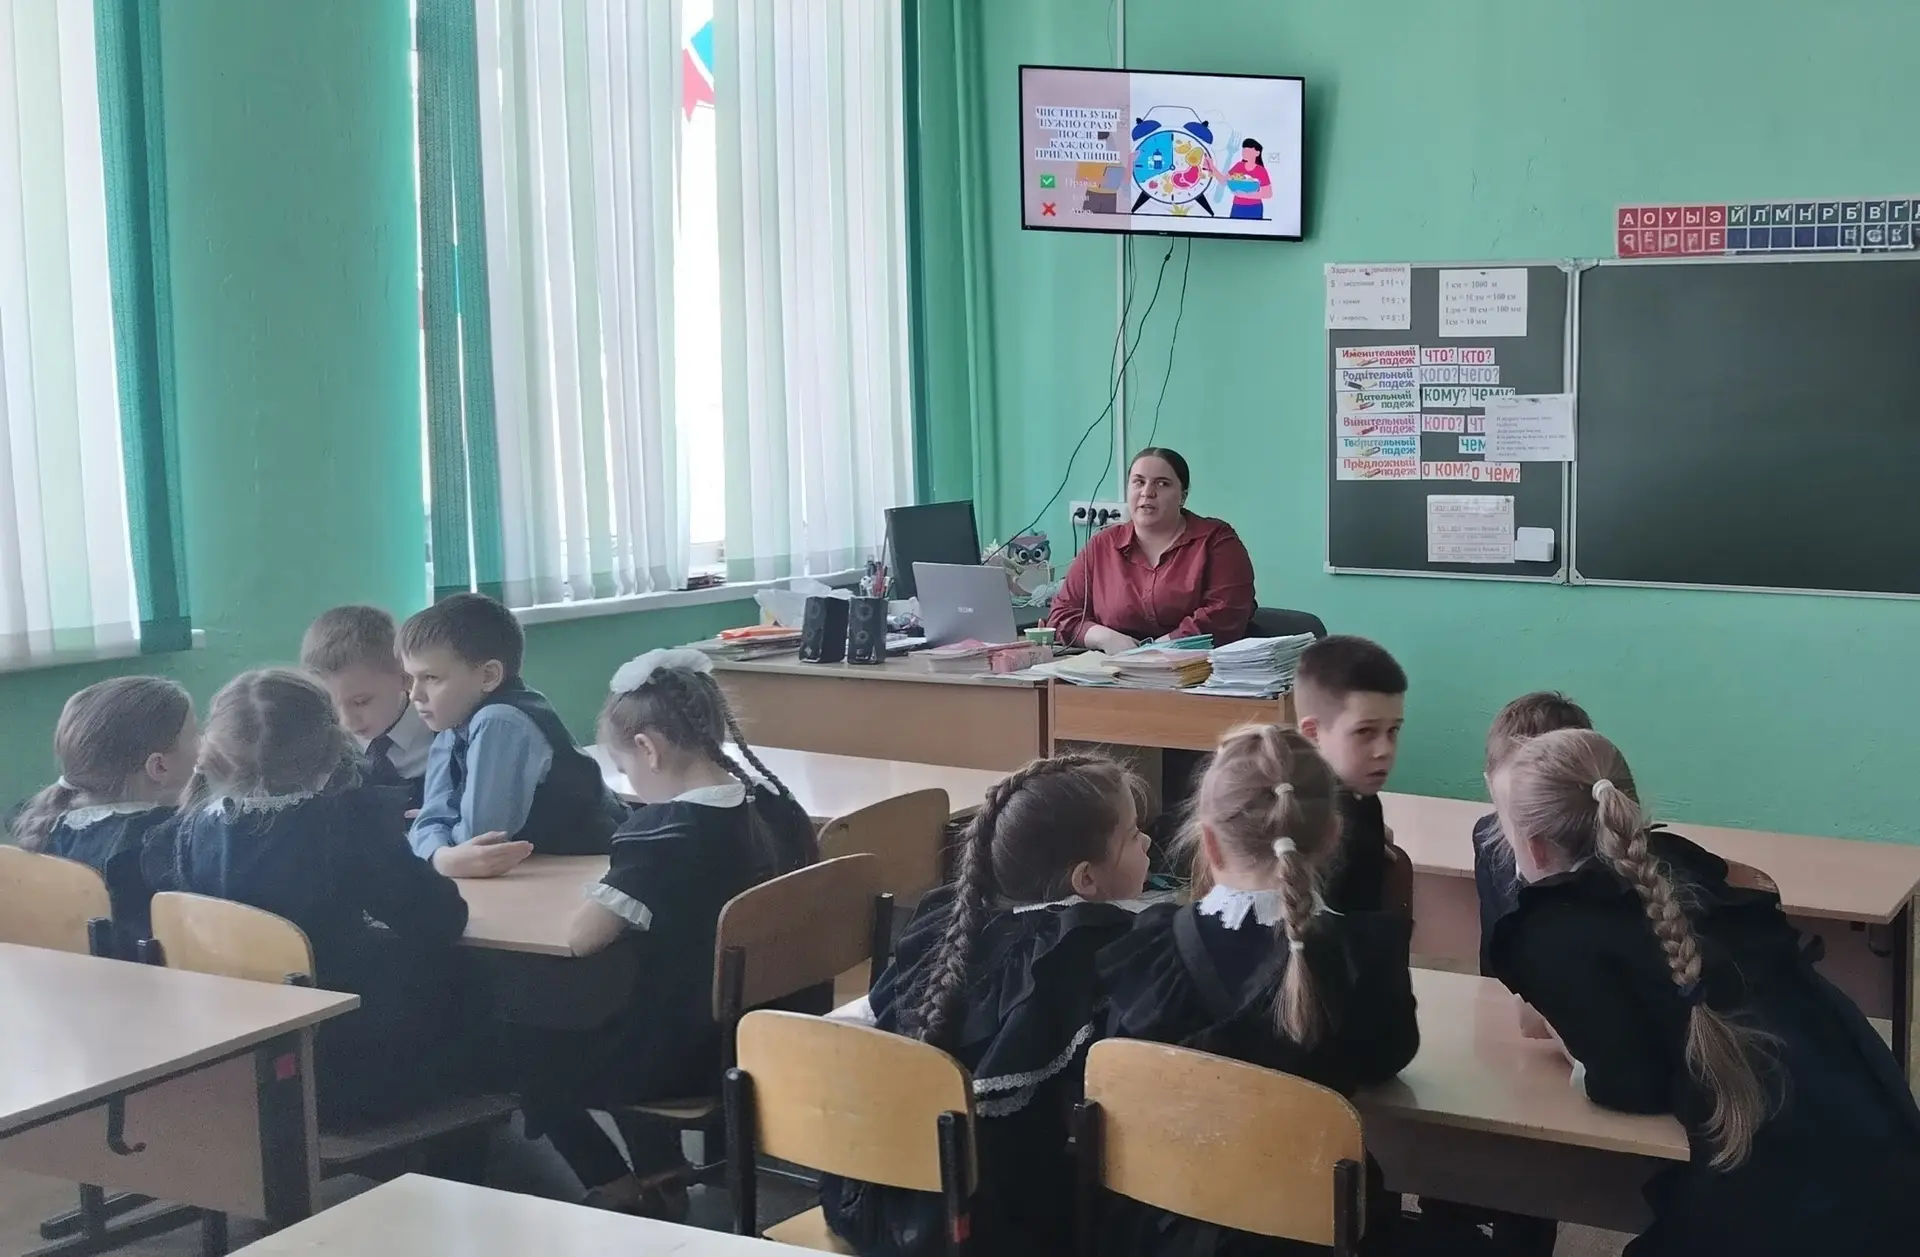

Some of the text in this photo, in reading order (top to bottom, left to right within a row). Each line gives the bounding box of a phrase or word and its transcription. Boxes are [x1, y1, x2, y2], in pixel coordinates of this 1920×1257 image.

[1036, 107, 1118, 119] ЧИСТИТЬ ЗУБЫ
[1040, 118, 1113, 130] НУЖНО СРАЗУ
[1058, 130, 1096, 139] ПОСЛЕ
[1049, 141, 1104, 150] КАЖДОГО
[1623, 213, 1634, 226] А
[1643, 212, 1656, 225] О
[1666, 211, 1677, 224] У
[1686, 211, 1699, 224] Ы
[1709, 211, 1721, 223] Э
[1731, 206, 1743, 222] Й
[1753, 209, 1766, 222] Л
[1776, 209, 1789, 222] М
[1799, 208, 1812, 221] Н
[1822, 208, 1834, 220] Р
[1846, 207, 1857, 220] Б
[1869, 206, 1881, 219] В
[1894, 205, 1904, 218] Г
[1342, 347, 1416, 358] Именительный
[1425, 348, 1492, 363] что? кто?
[1379, 357, 1416, 367] падеж
[1343, 368, 1413, 381] Родительный
[1420, 367, 1499, 382] кого? чего?
[1378, 380, 1415, 390] падеж
[1356, 390, 1412, 403] Дательный
[1424, 388, 1467, 406] кому?
[1381, 400, 1415, 410] падеж
[1343, 415, 1416, 426] Винительный
[1424, 415, 1463, 431] кого?
[1379, 425, 1416, 434] падеж
[1381, 446, 1416, 456] падеж
[1343, 456, 1416, 471] Предложный
[1381, 468, 1417, 478] падеж
[1423, 463, 1470, 477] о ком?
[1471, 463, 1520, 482] о чём?
